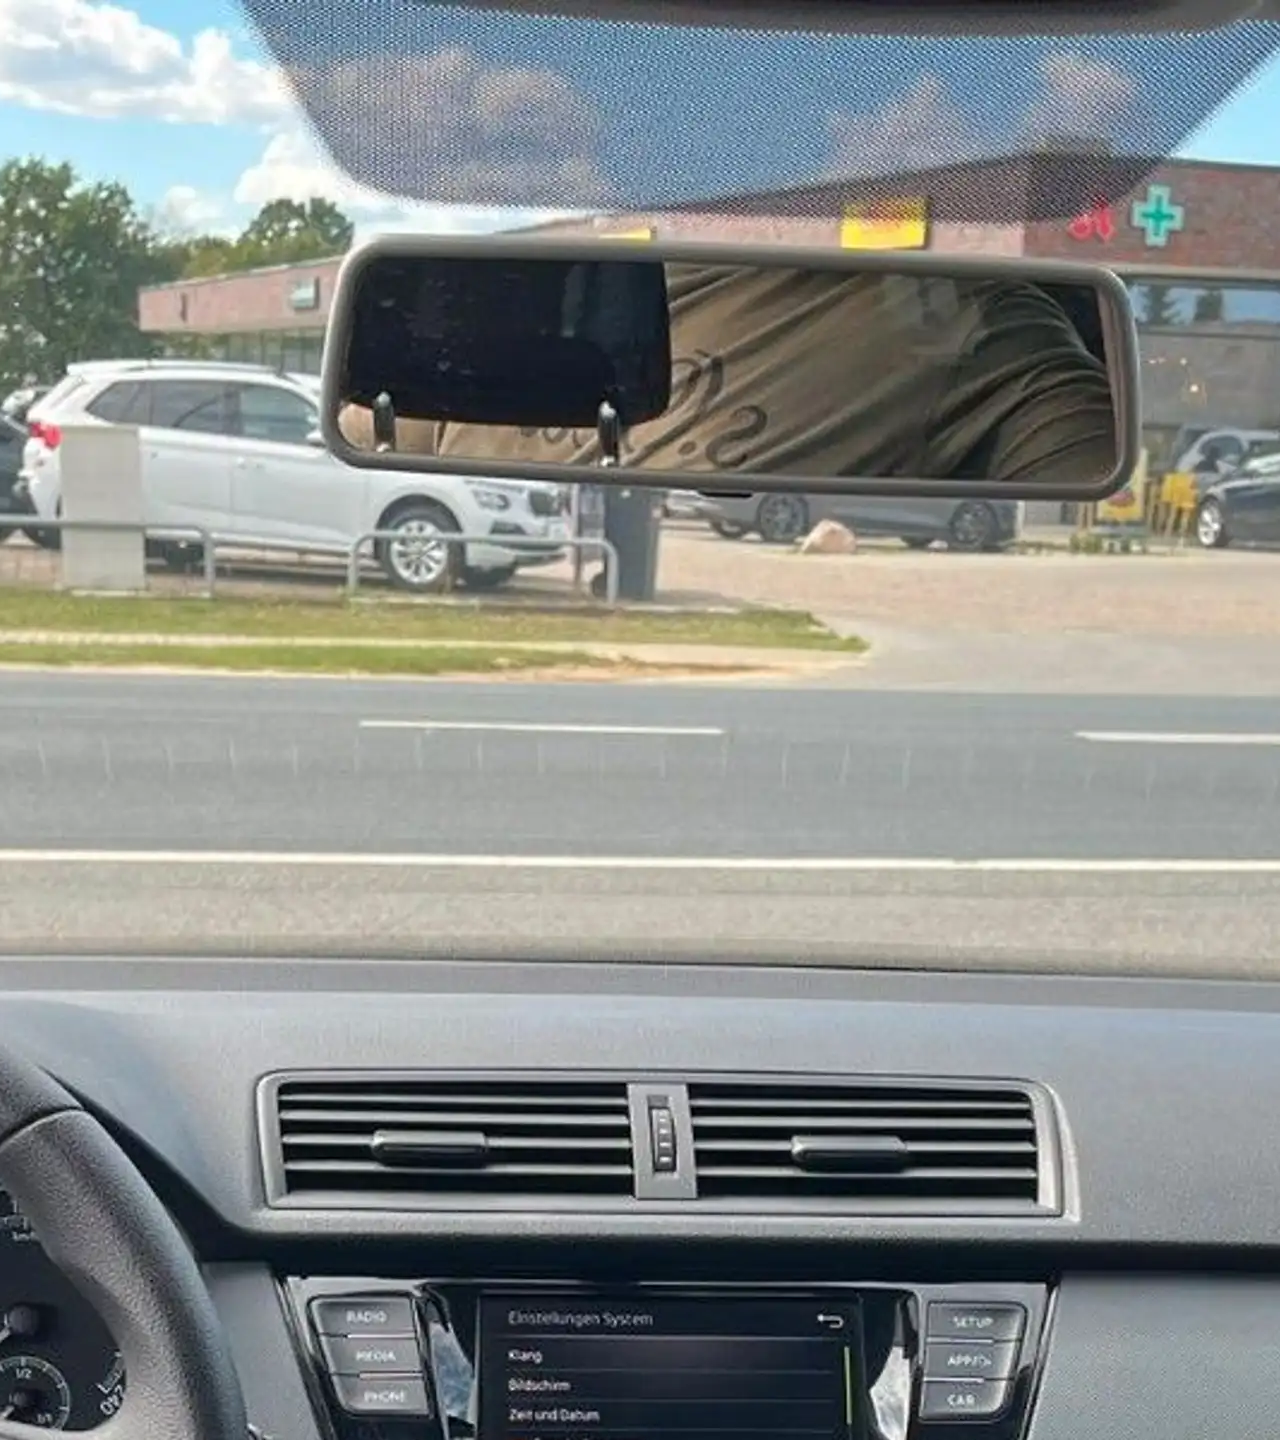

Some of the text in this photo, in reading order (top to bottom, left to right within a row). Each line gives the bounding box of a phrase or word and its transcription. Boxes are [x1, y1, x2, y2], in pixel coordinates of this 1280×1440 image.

[346, 1310, 388, 1323] RADIO
[507, 1309, 654, 1328] Einstellungen System
[952, 1315, 994, 1329] SETUP
[356, 1350, 397, 1362] MEDIA
[507, 1349, 544, 1365] Klang
[15, 1367, 32, 1380] 1/2
[507, 1377, 571, 1392] Bildschirm
[363, 1390, 406, 1404] PHONE
[946, 1393, 976, 1407] CAR
[508, 1408, 601, 1422] Zeit und Datum
